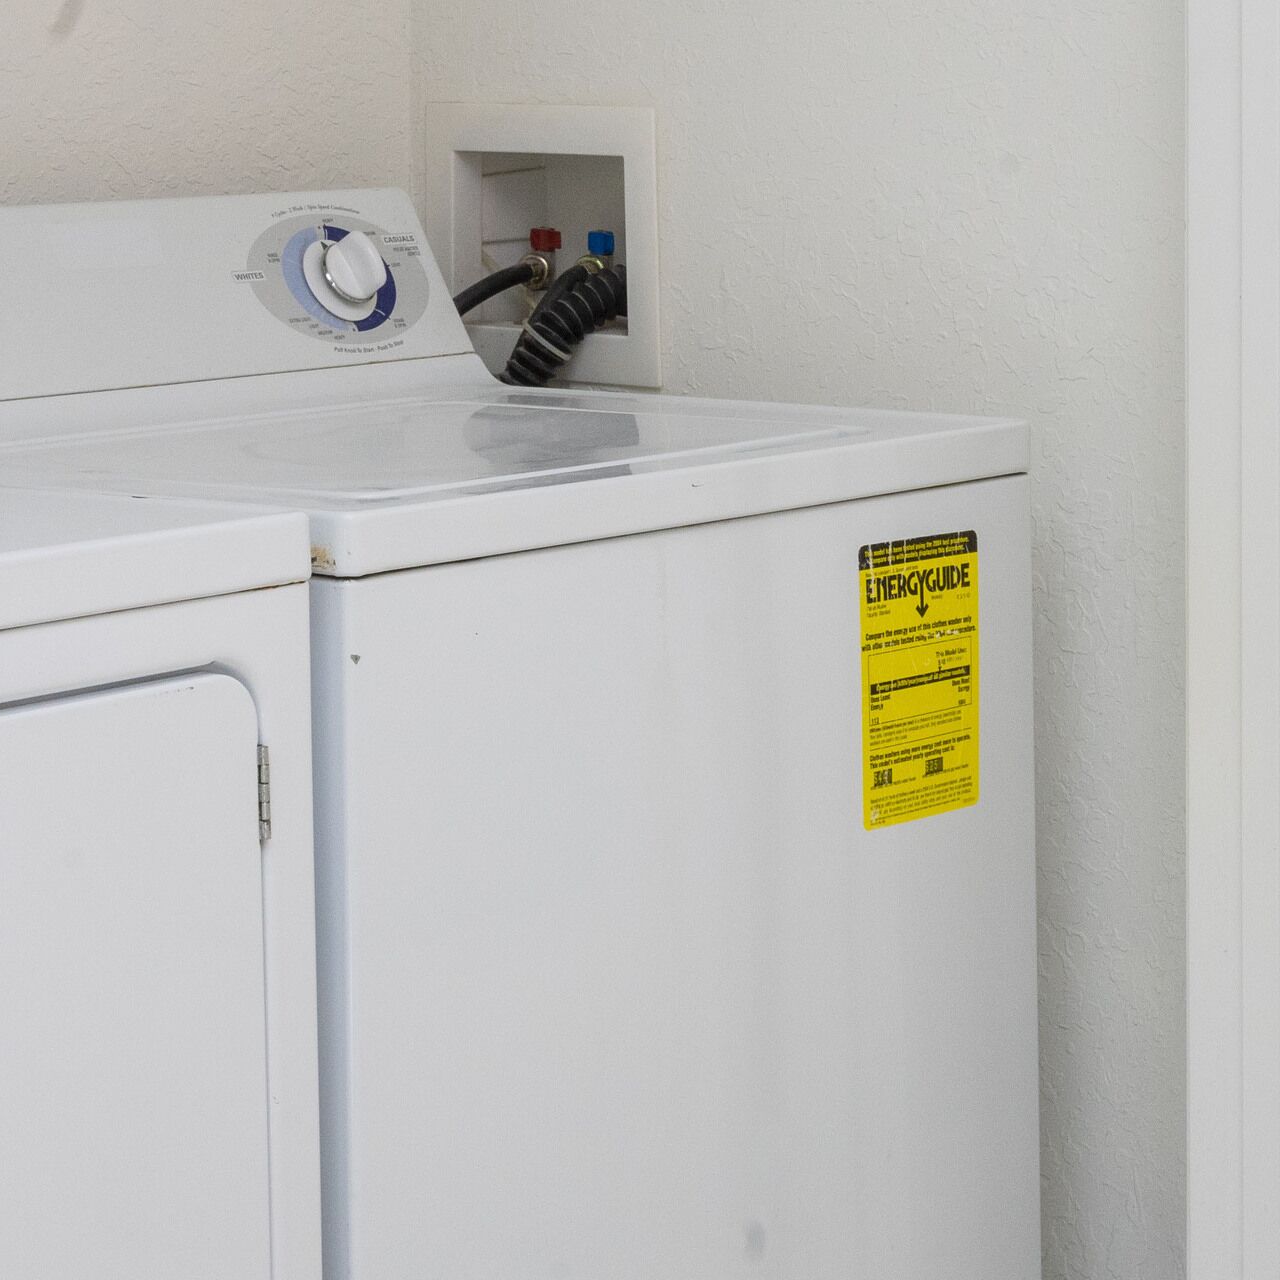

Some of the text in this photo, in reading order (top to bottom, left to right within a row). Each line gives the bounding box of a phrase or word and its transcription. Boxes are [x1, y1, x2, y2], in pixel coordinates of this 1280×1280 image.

[383, 235, 414, 243] CASUALS
[234, 272, 264, 280] WHITES
[865, 562, 971, 604] ENERGYGUIDE
[865, 632, 884, 641] Compare
[893, 628, 908, 636] energy
[932, 620, 947, 629] clothes
[963, 616, 972, 624] only
[862, 644, 872, 652] with
[900, 636, 914, 644] tested
